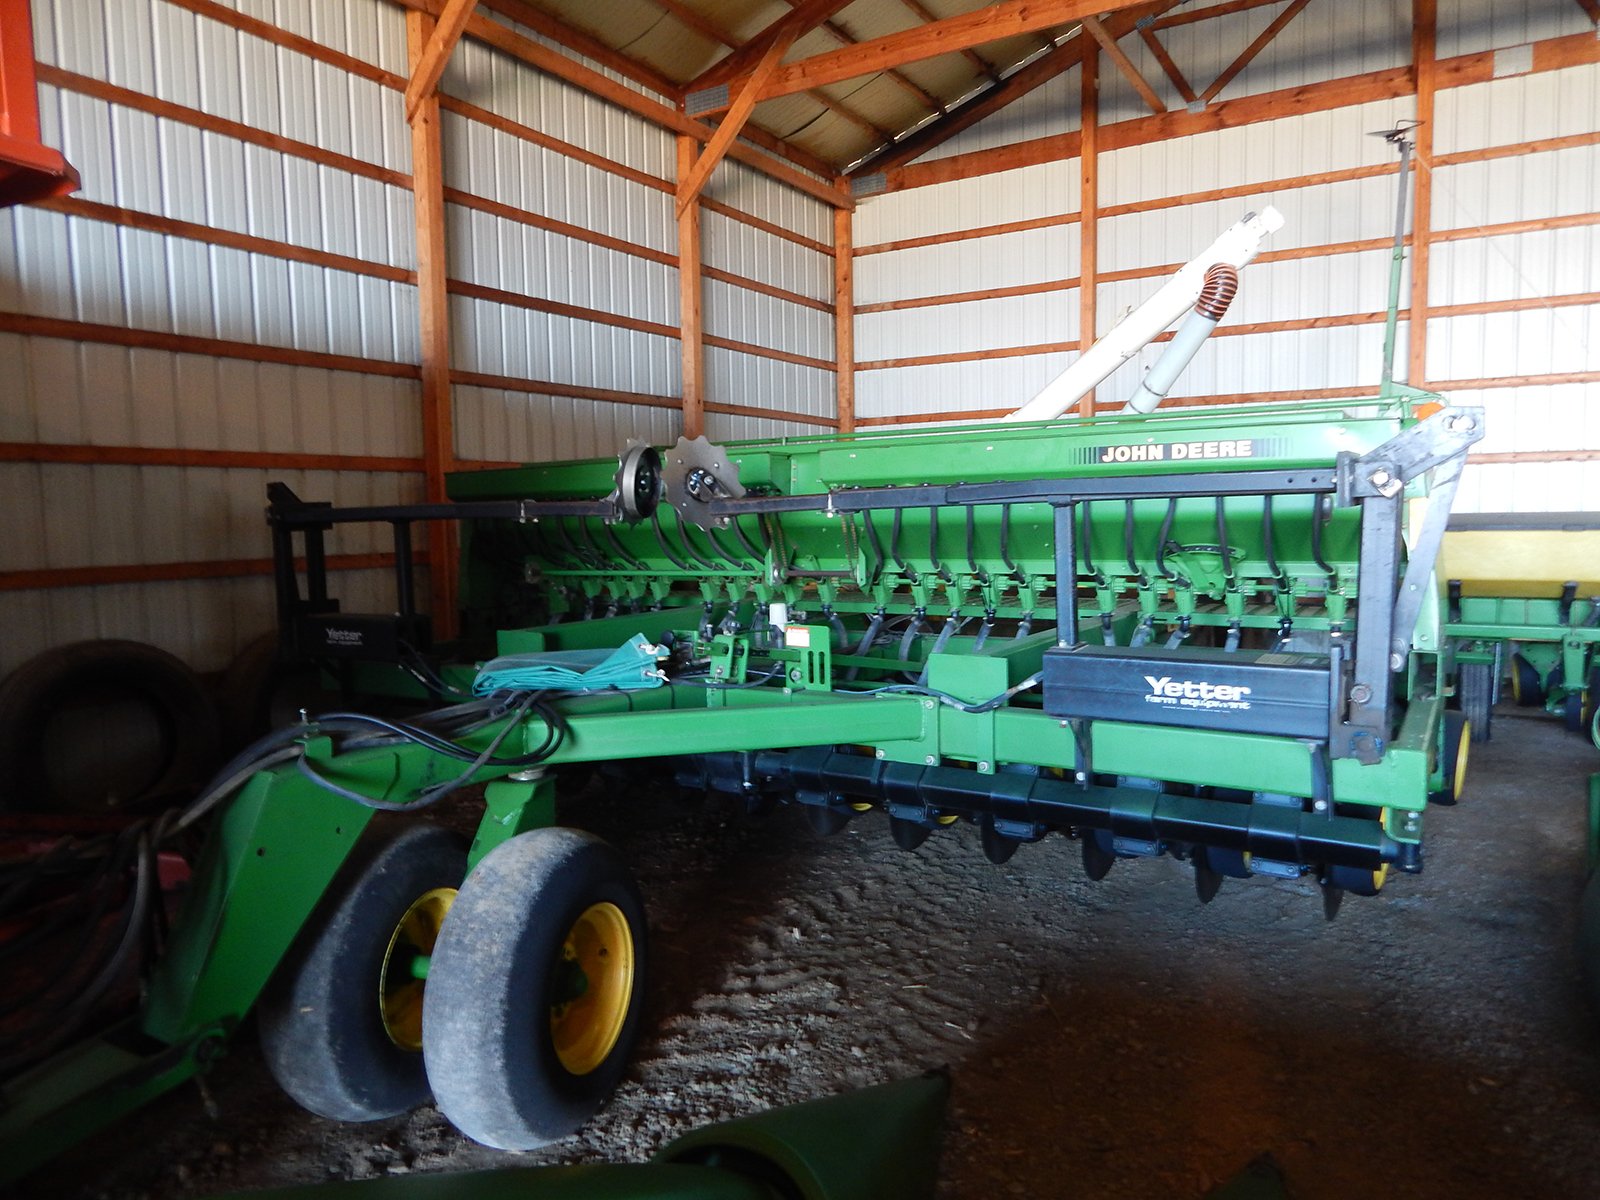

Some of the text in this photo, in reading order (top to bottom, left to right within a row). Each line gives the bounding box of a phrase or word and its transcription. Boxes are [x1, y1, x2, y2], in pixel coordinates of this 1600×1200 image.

[1102, 440, 1252, 462] JOHN DEERE
[1144, 675, 1252, 701] Yetter
